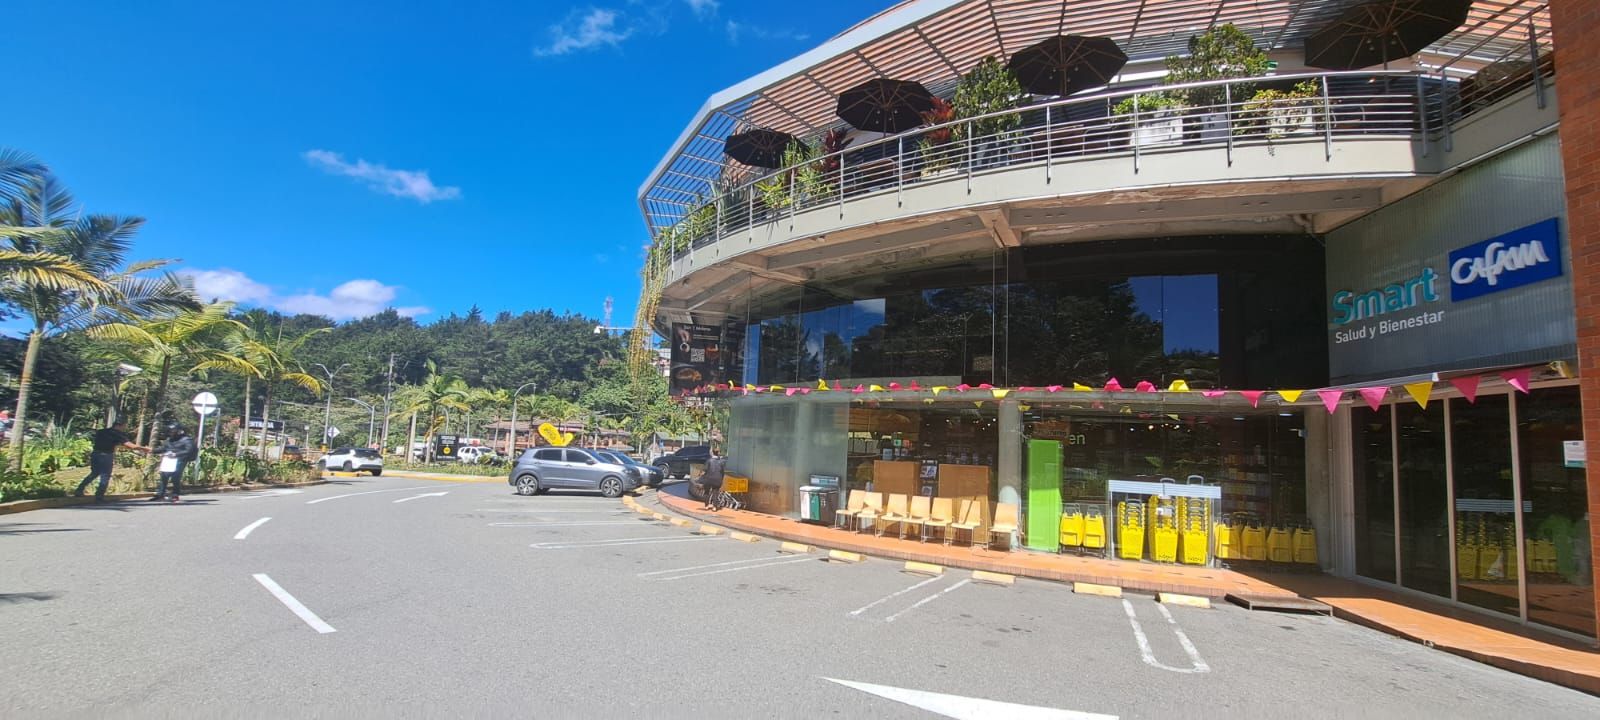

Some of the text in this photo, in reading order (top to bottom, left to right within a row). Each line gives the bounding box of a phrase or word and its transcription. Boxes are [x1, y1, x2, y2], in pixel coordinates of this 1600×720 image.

[1332, 267, 1439, 325] Smart
[1335, 309, 1445, 344] Salud y Bienestar
